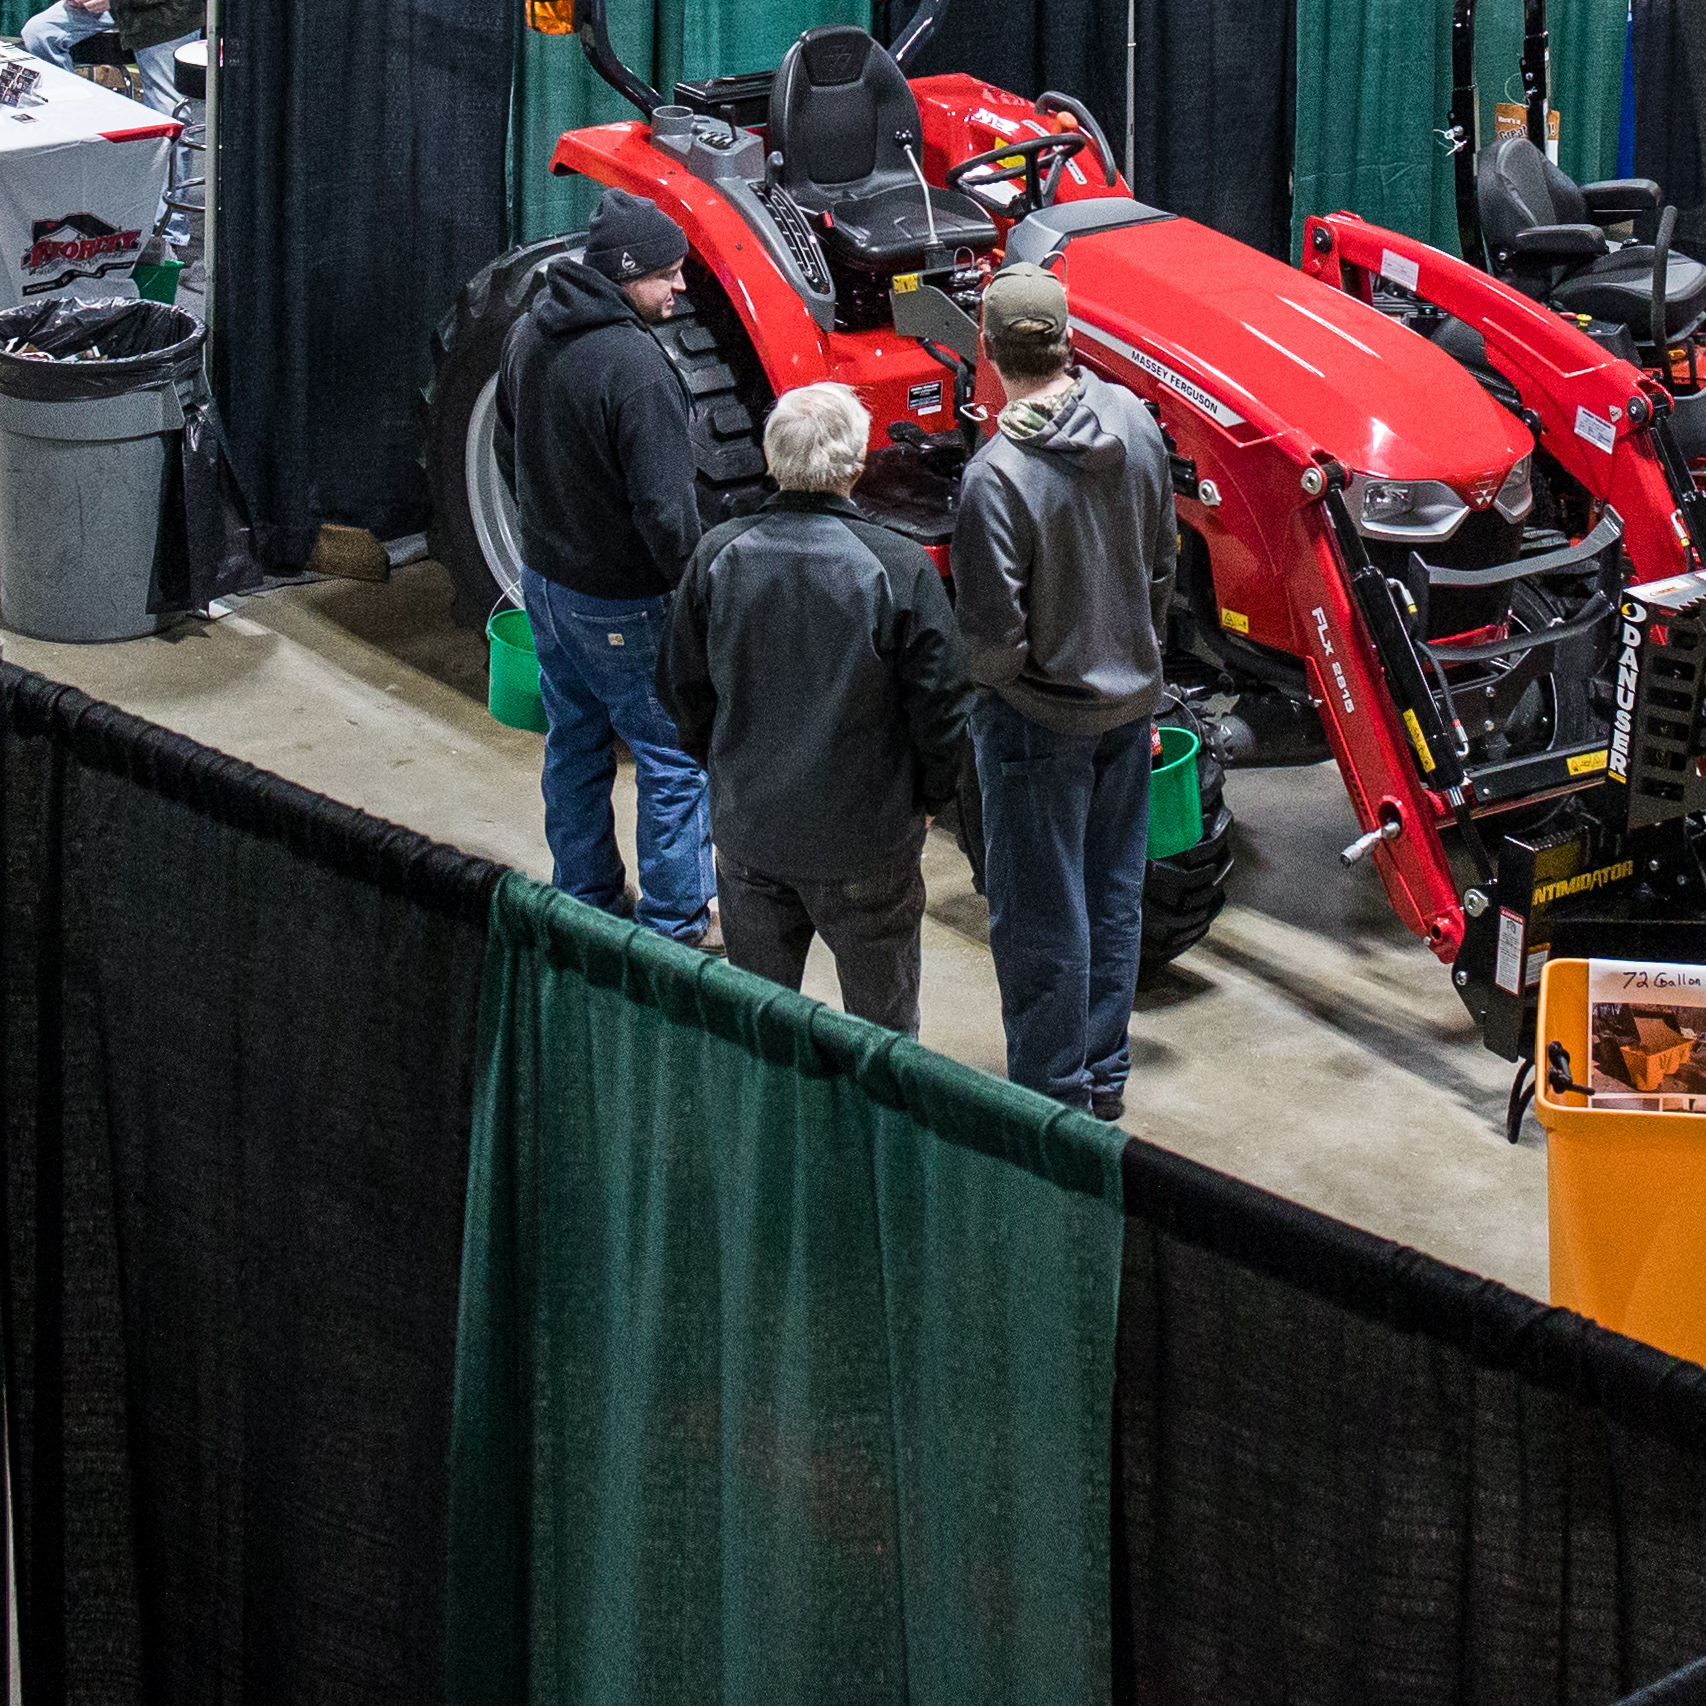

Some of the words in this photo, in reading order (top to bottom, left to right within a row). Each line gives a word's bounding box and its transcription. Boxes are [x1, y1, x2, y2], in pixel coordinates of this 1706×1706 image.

[1130, 349, 1169, 381] MASSEY
[1170, 373, 1219, 416] FERGUSON
[1311, 606, 1335, 657] FLX
[1608, 624, 1642, 778] DANUSER
[1623, 970, 1649, 990] 72
[1652, 972, 1702, 989] Gallon
